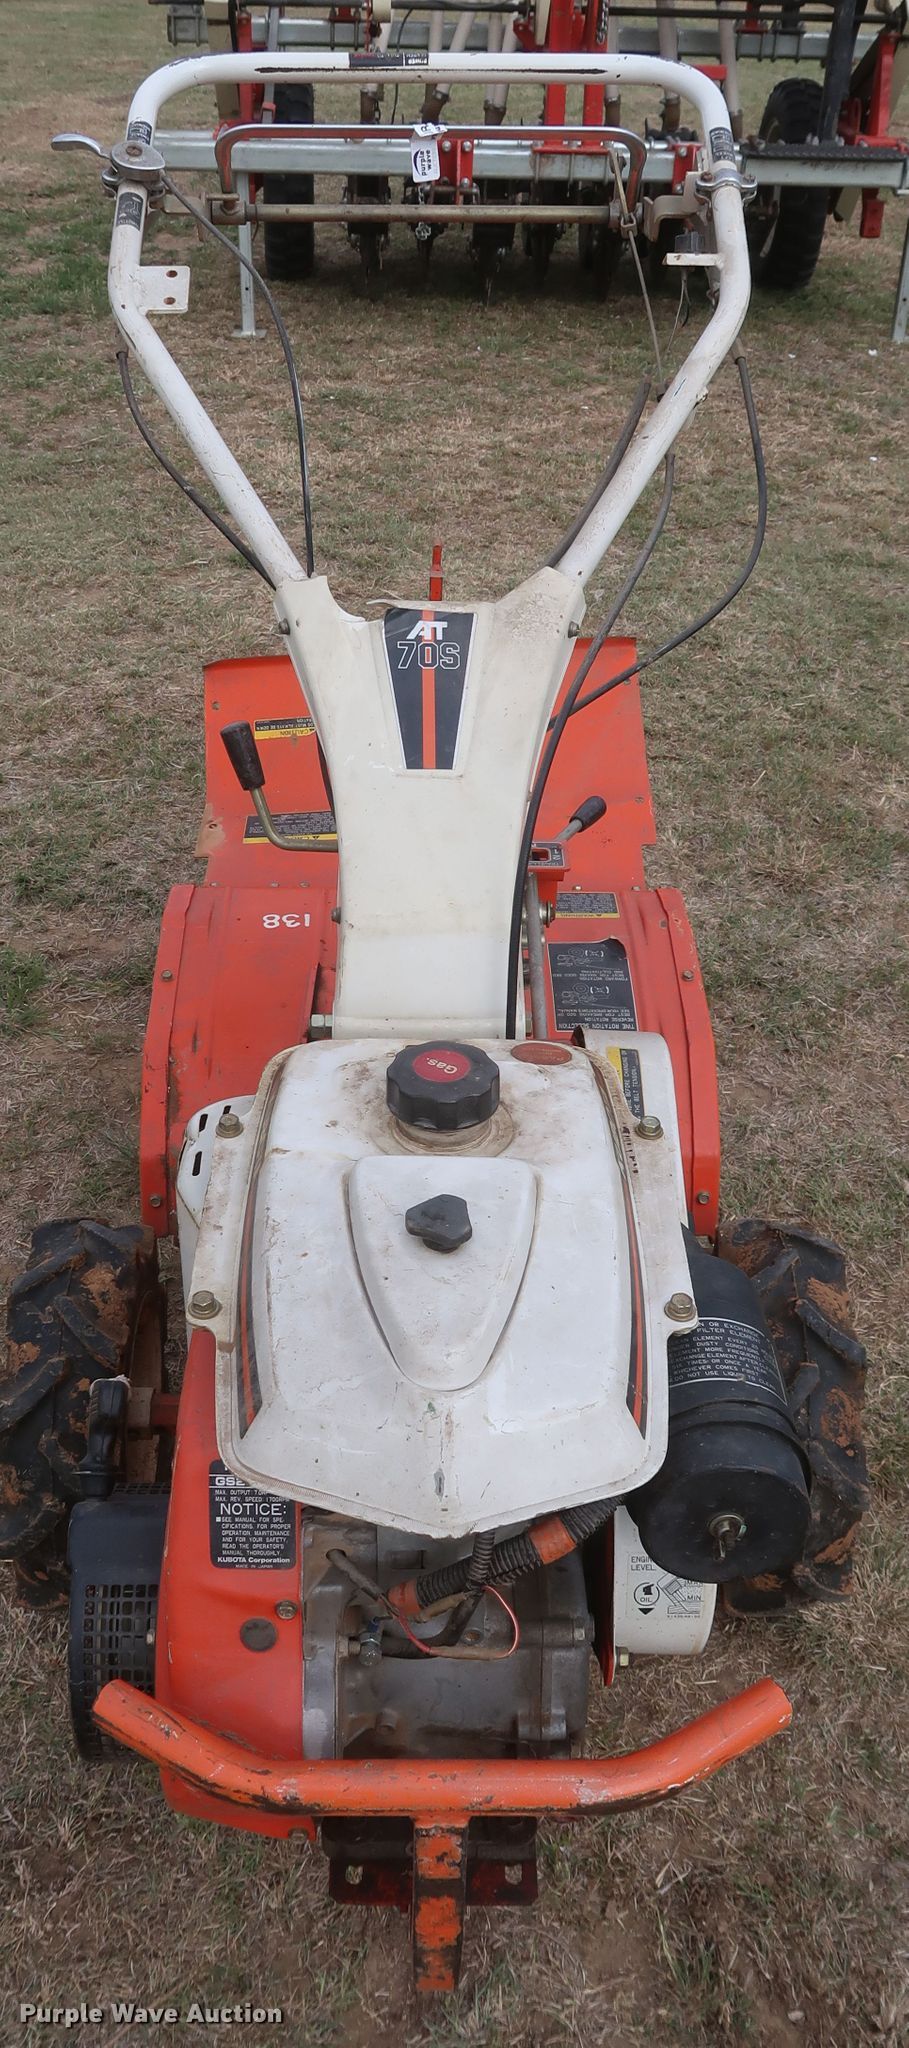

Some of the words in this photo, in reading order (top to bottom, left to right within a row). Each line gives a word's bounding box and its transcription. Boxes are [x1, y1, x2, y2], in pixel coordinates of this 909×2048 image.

[419, 150, 428, 176] purple
[406, 620, 448, 640] AT
[397, 641, 460, 670] 70S
[262, 914, 310, 928] 138
[426, 1058, 458, 1074] Gas.
[220, 1504, 287, 1516] NOTICE:
